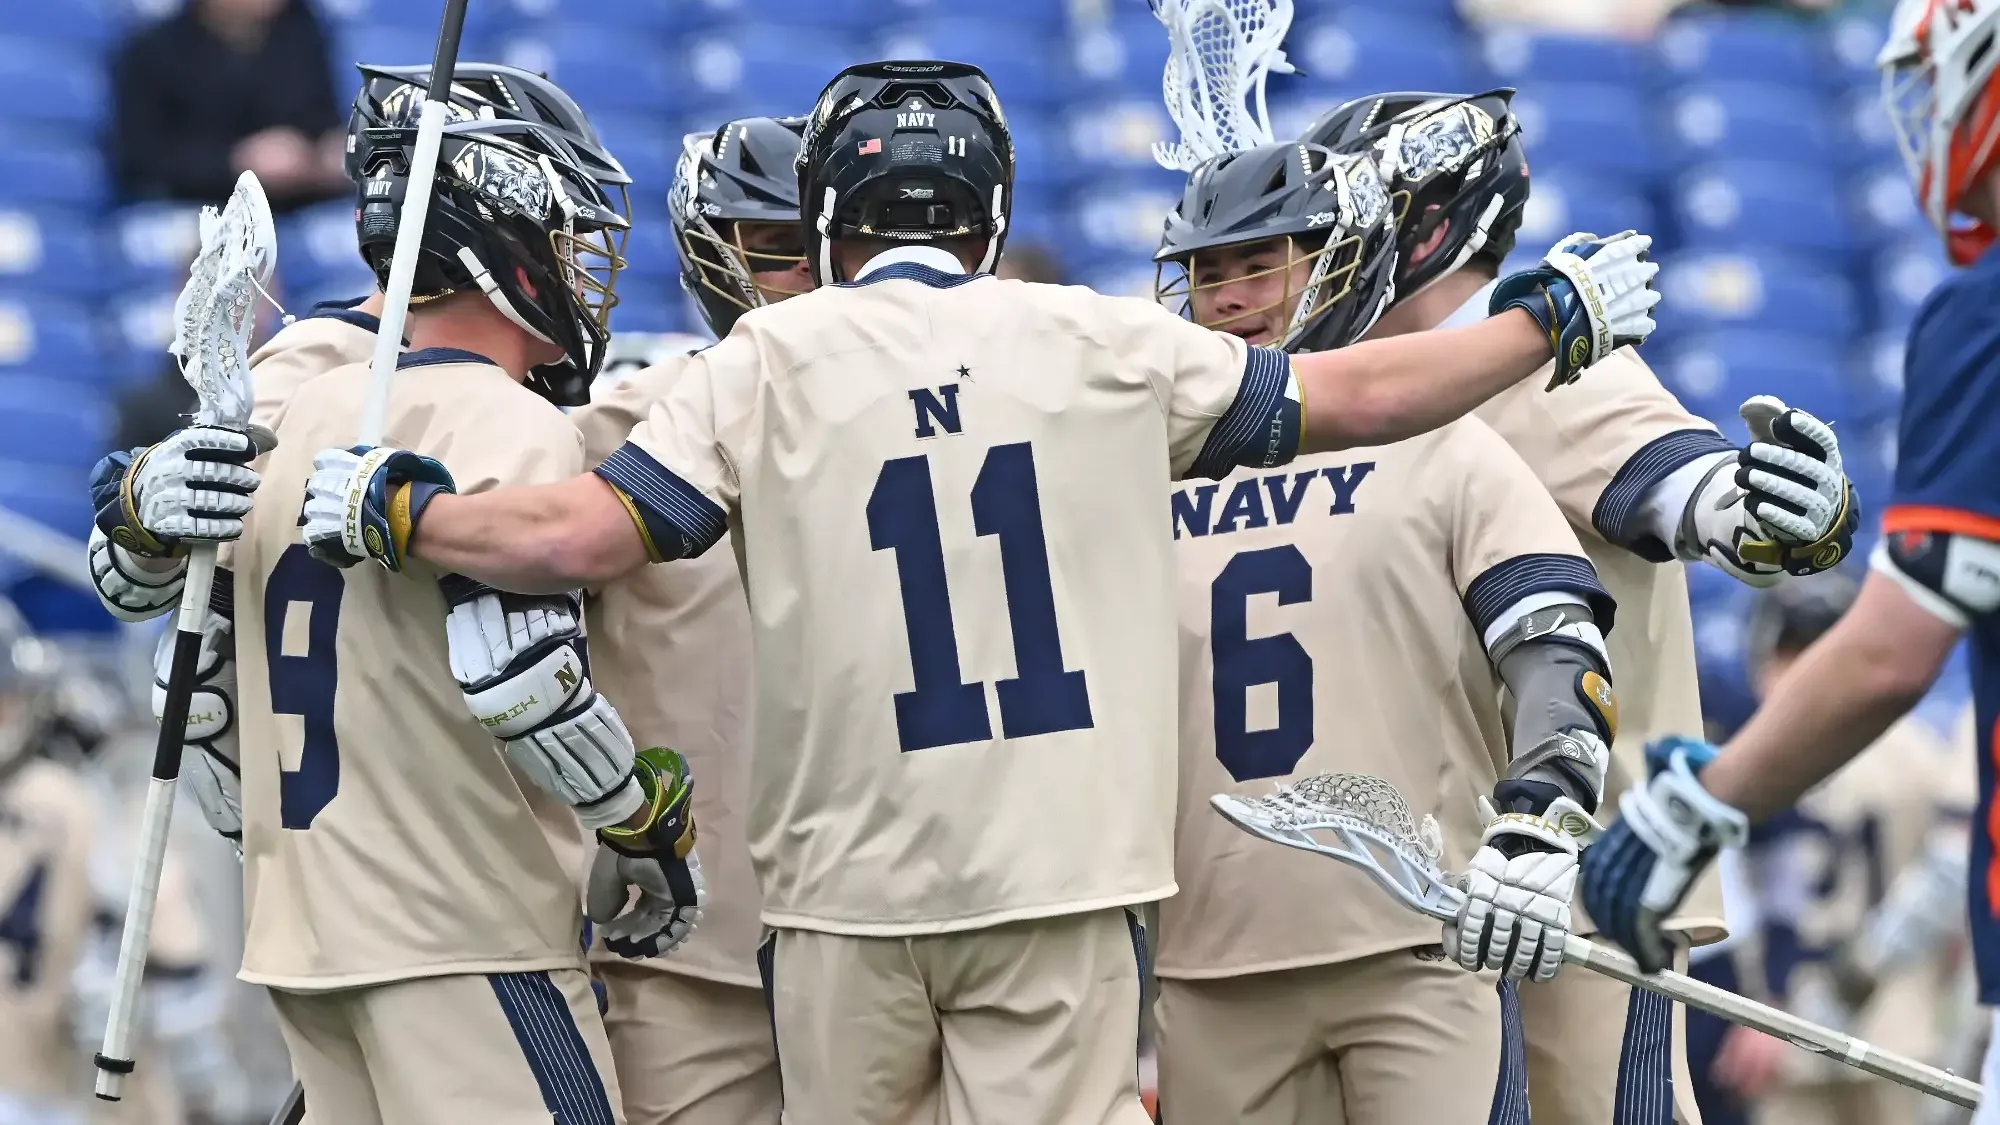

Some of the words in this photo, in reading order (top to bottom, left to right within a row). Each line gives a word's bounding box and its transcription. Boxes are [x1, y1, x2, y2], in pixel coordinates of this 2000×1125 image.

[897, 113, 935, 127] NAVY
[948, 135, 966, 157] 11
[366, 181, 393, 196] NAVY
[908, 383, 964, 440] N
[1263, 407, 1284, 468] ERIK
[1171, 461, 1376, 541] NAVY
[866, 441, 1094, 753] 11
[265, 543, 345, 830] 9
[554, 661, 578, 694] N
[1211, 544, 1315, 783] 6
